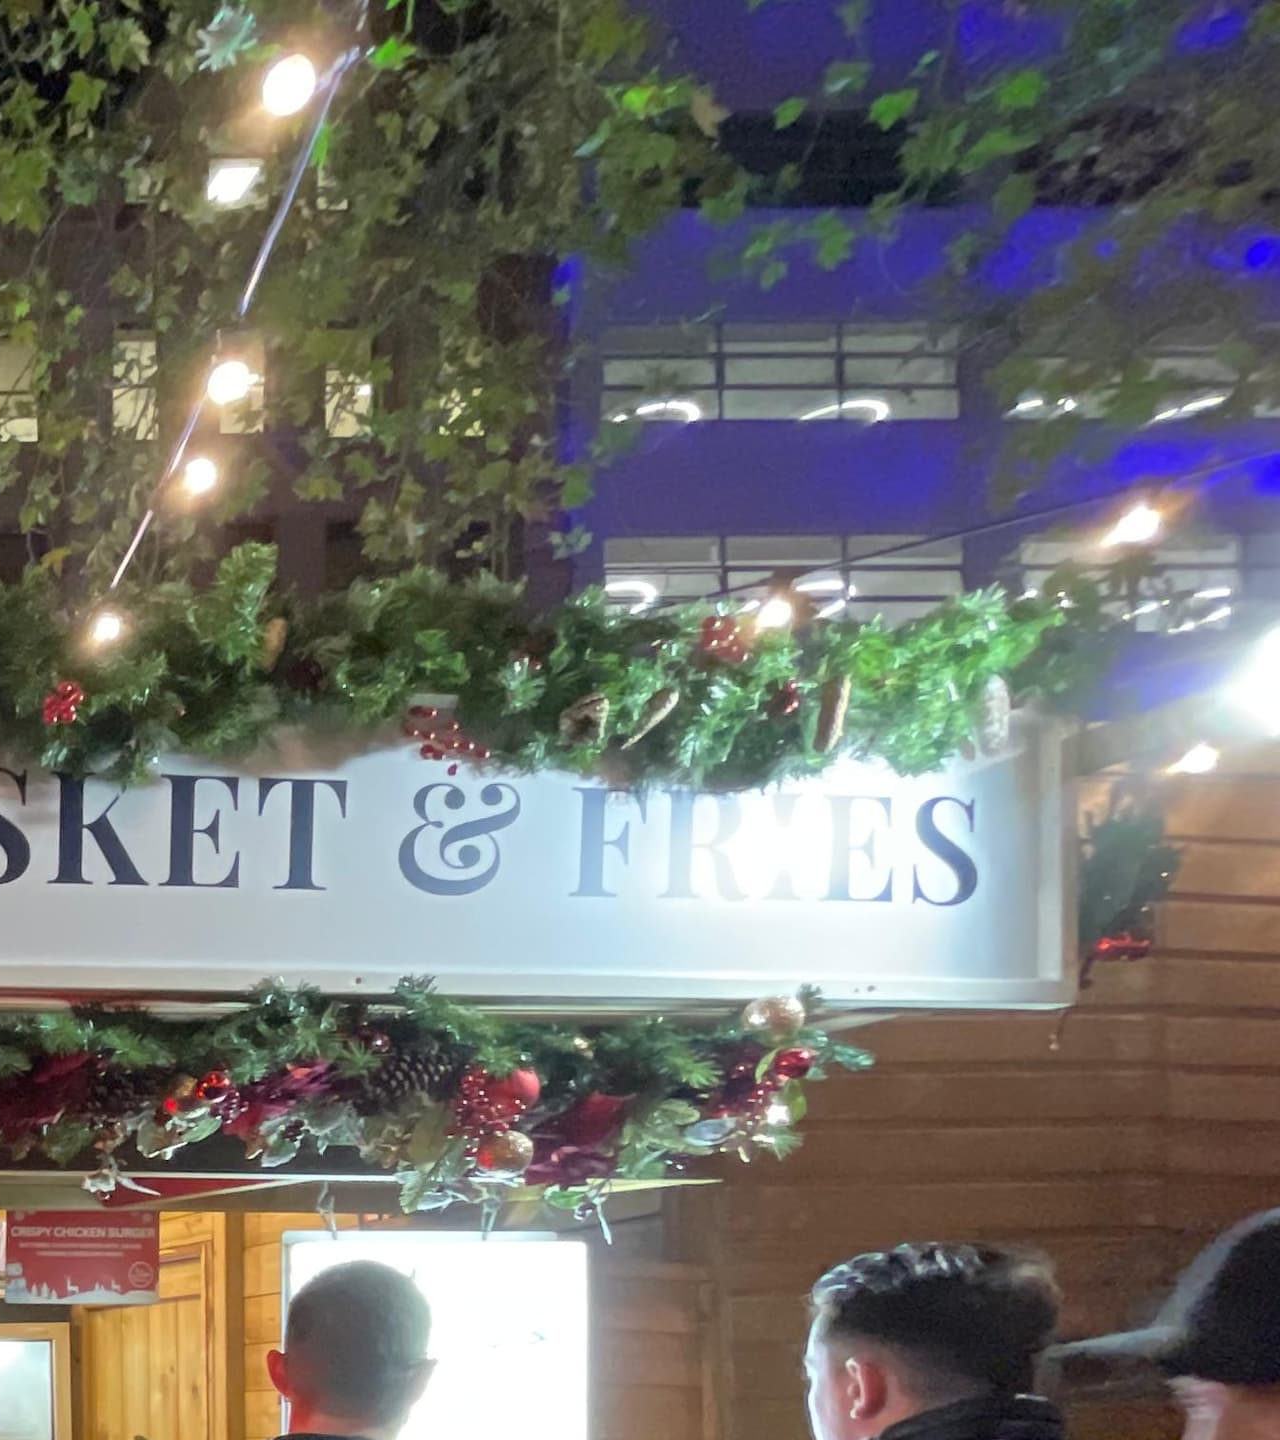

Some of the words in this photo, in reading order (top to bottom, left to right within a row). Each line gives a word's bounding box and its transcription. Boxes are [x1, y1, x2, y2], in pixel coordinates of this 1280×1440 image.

[397, 781, 521, 896] &
[568, 784, 980, 908] FRIES
[54, 1226, 106, 1238] CHICKEN
[107, 1226, 155, 1239] BURGER
